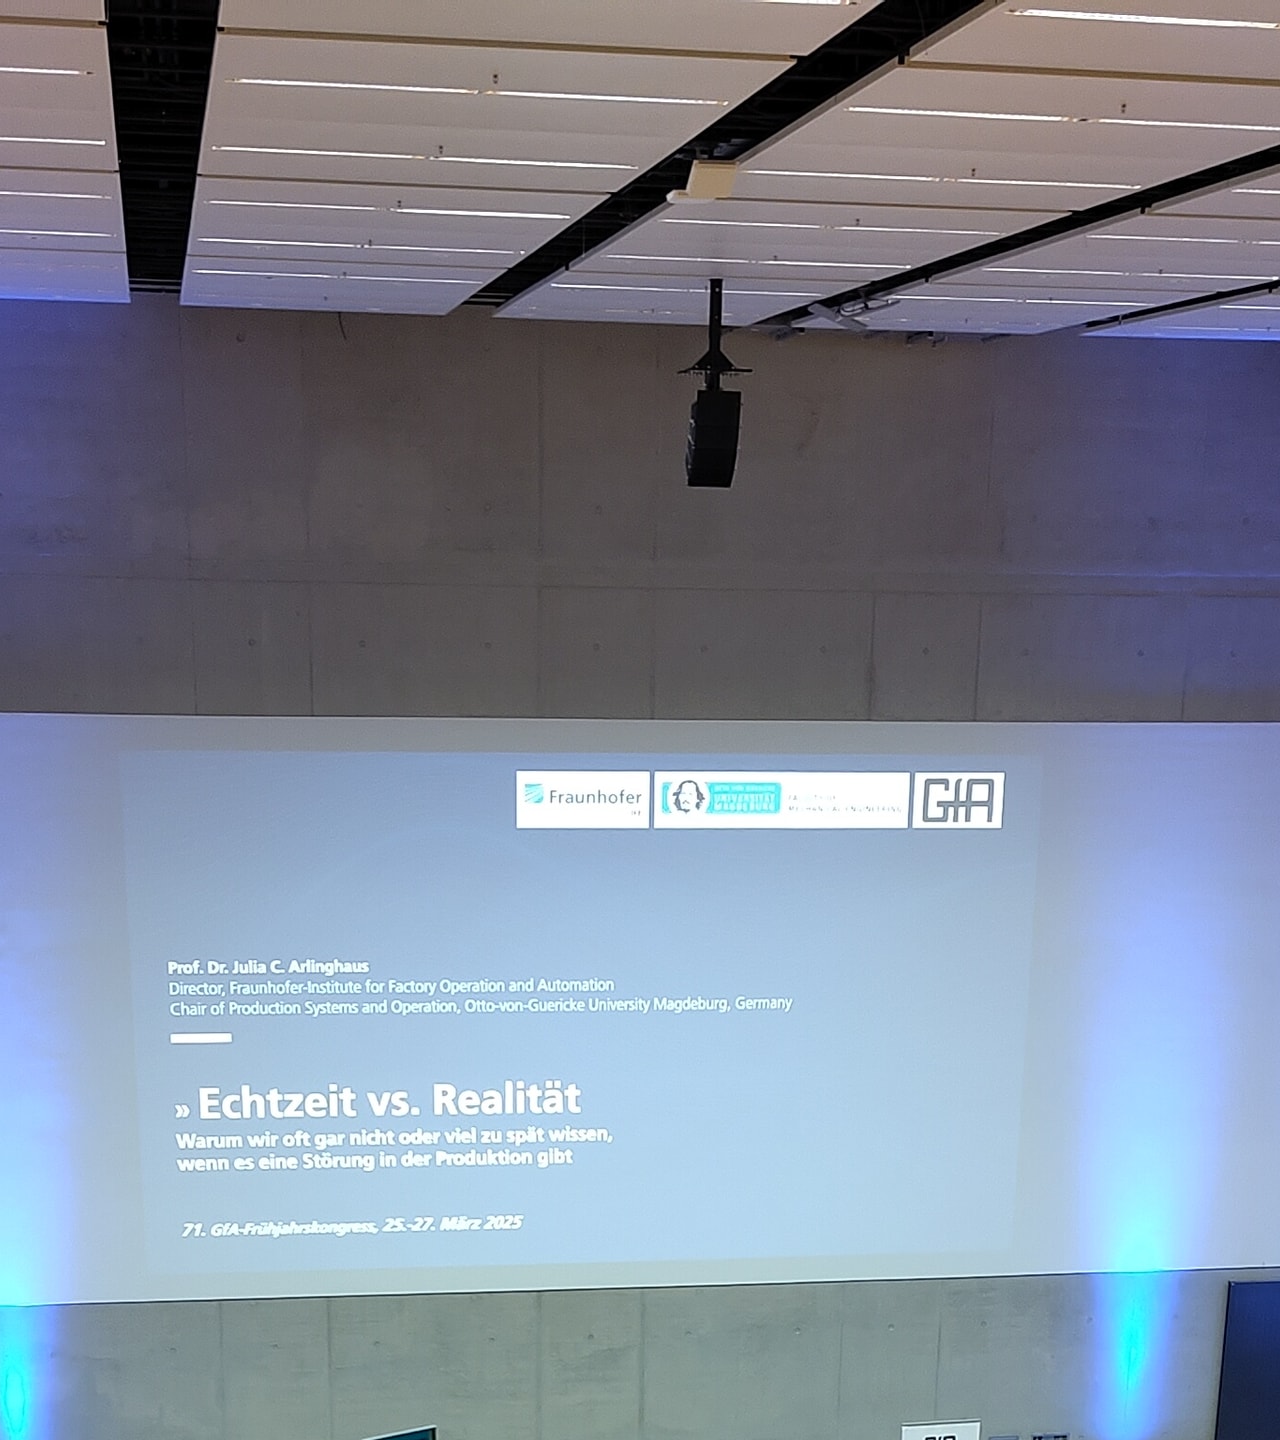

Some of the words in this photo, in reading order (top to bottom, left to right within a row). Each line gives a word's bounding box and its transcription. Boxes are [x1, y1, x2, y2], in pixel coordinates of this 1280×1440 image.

[549, 789, 642, 805] Fraunhofer
[167, 959, 205, 975] Prof.
[207, 960, 229, 974] Dr.
[231, 959, 267, 974] Julia
[269, 959, 286, 974] C.
[287, 958, 370, 977] Arlinghaus
[168, 981, 226, 997] Director,
[229, 979, 362, 995] Fraunhofer-Institute
[364, 978, 386, 994] for
[388, 979, 437, 996] Factory
[439, 978, 506, 996] Operation
[508, 977, 535, 993] and
[536, 977, 615, 992] Automation
[169, 1001, 208, 1016] Chair
[210, 1000, 226, 1016] of
[229, 1000, 302, 1015] Production
[304, 1001, 359, 1018] Systems
[361, 999, 388, 1014] and
[390, 999, 461, 1016] Operation,
[464, 997, 586, 1013] Otto-von-Guericke
[588, 996, 651, 1014] University
[653, 995, 731, 1014] Magdeburg,
[735, 996, 793, 1013] Germany
[199, 1083, 357, 1119] Echtzeit
[366, 1091, 420, 1117] vs.
[433, 1080, 582, 1116] Realität
[175, 1133, 243, 1149] Warum
[246, 1130, 279, 1148] wir
[282, 1130, 312, 1147] oft
[314, 1133, 346, 1151] gar
[349, 1128, 396, 1146] nicht
[398, 1127, 441, 1145] oder
[444, 1126, 477, 1144] viel
[480, 1130, 503, 1144] zu
[506, 1125, 545, 1147] spät
[548, 1125, 613, 1143] wissen,
[176, 1158, 230, 1172] wenn
[233, 1157, 255, 1170] es
[258, 1153, 299, 1170] eine
[302, 1151, 375, 1172] Störung
[379, 1151, 397, 1168] in
[400, 1150, 433, 1167] der
[435, 1148, 533, 1166] Produktion
[536, 1147, 573, 1168] gibt
[181, 1222, 207, 1237] 71.
[210, 1220, 379, 1238] GfA-Frühjahrskongress,
[439, 1215, 481, 1231] März
[484, 1214, 525, 1230] 2025
